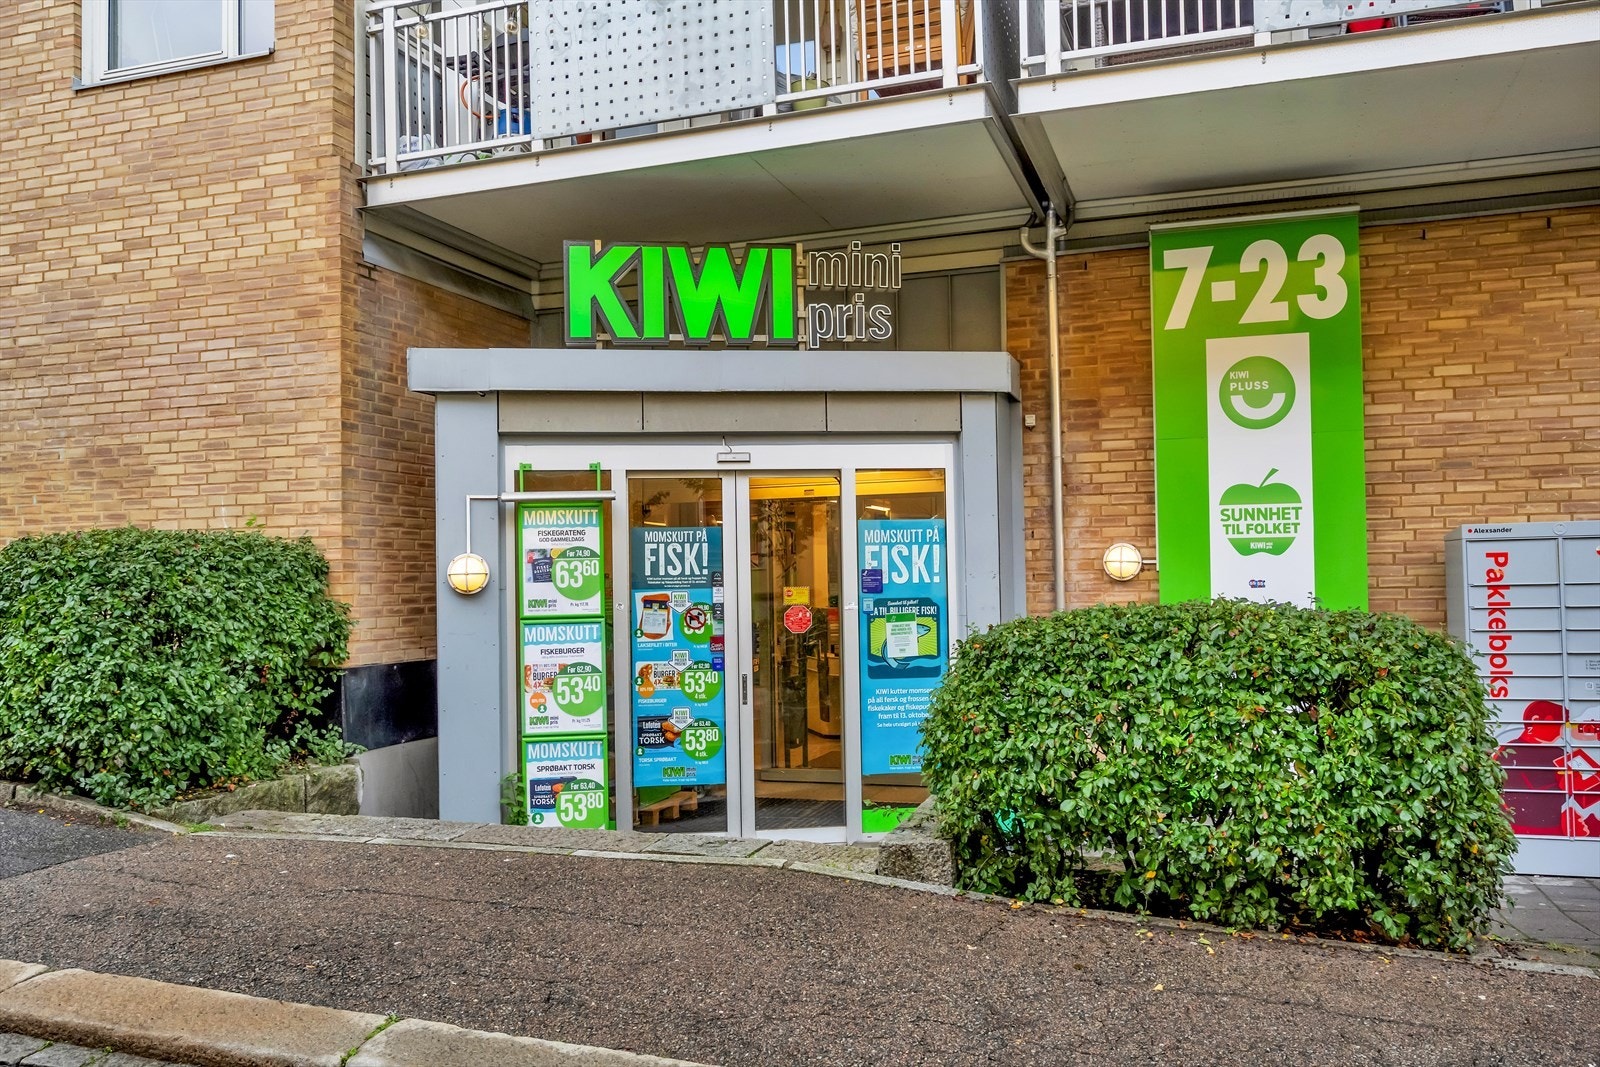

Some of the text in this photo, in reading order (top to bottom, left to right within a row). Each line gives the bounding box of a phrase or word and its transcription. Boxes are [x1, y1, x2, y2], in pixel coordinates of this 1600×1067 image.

[808, 241, 901, 289] mini
[1163, 234, 1348, 330] 7-23
[566, 243, 797, 343] KIWI
[808, 293, 893, 349] pris
[1229, 371, 1249, 379] KIWI
[1229, 381, 1269, 391] PLUSS
[524, 510, 599, 525] MOMSKUTT
[1220, 507, 1303, 521] SUNNHET
[644, 528, 708, 542] MOMSKUTT PÅ
[864, 525, 939, 543] MOMSKUTT PÅ
[1223, 523, 1301, 535] TIL FOLKET
[576, 549, 591, 557] 74,90
[644, 542, 709, 576] FISK!
[864, 544, 940, 584] FISK!
[528, 599, 547, 608] KIWI
[921, 606, 937, 615] FISK!
[524, 625, 599, 643] MOMSKUTT
[540, 647, 585, 655] FISKEBURGER
[576, 665, 592, 673] 62,90
[868, 696, 875, 704] på
[529, 716, 549, 726] KIWI
[528, 741, 602, 759] MOMSKUTT
[889, 754, 912, 765] KIWI
[536, 763, 596, 772] SPRØBAKT TORSK
[662, 766, 685, 777] KIWI
